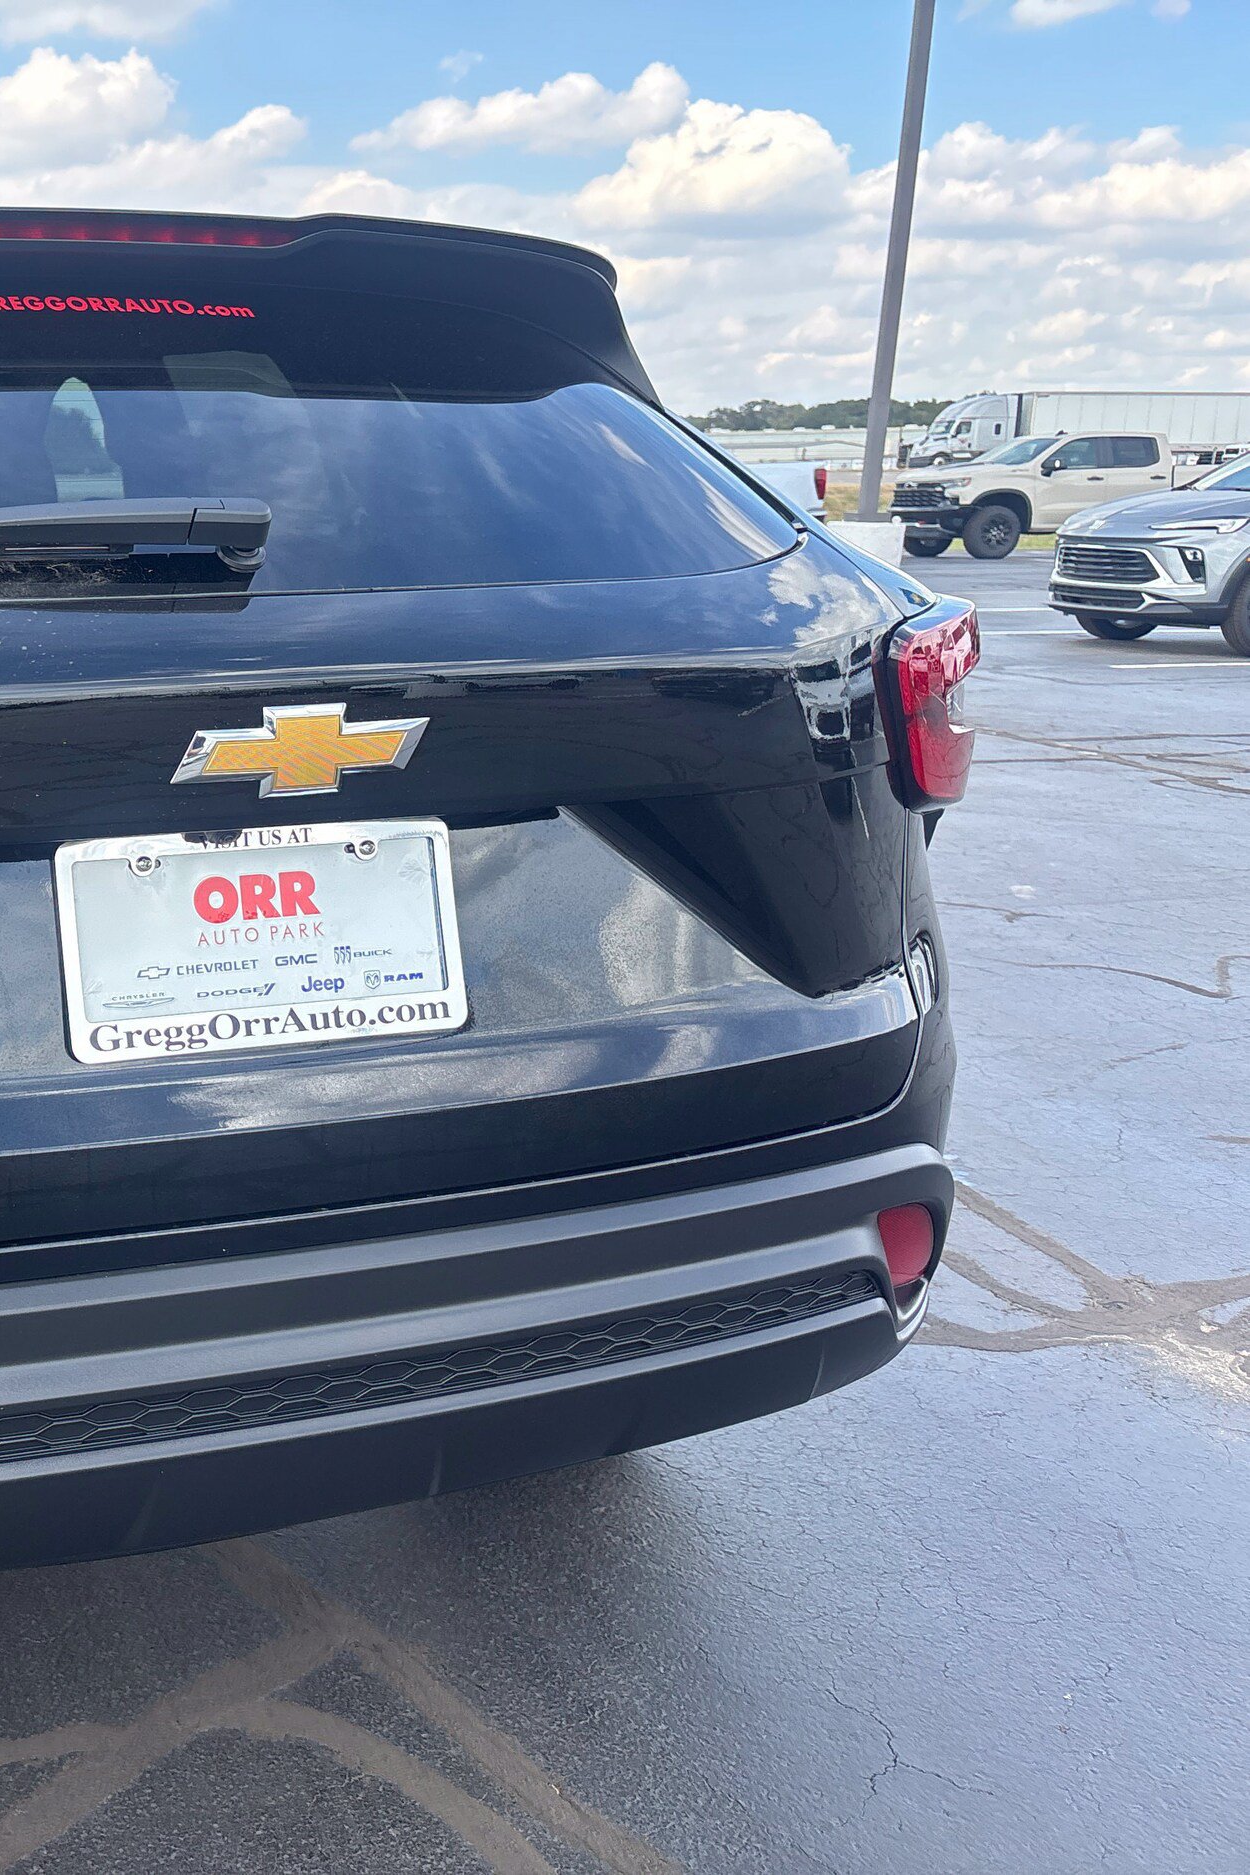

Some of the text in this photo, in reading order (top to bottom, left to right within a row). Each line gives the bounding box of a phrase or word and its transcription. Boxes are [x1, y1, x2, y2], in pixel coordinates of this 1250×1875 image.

[258, 829, 282, 846] US
[287, 827, 312, 844] AT
[193, 870, 321, 924] ORR
[197, 921, 325, 947] AUTO PARK
[274, 953, 318, 967] GMC
[353, 949, 392, 958] BUICK
[176, 959, 259, 976] CHEVROLET
[301, 976, 345, 993] Jeep
[384, 972, 424, 983] RAM
[112, 992, 166, 1001] CHRYSLER
[197, 986, 265, 998] DODGE
[89, 998, 452, 1053] GreggOrrAuto.com
